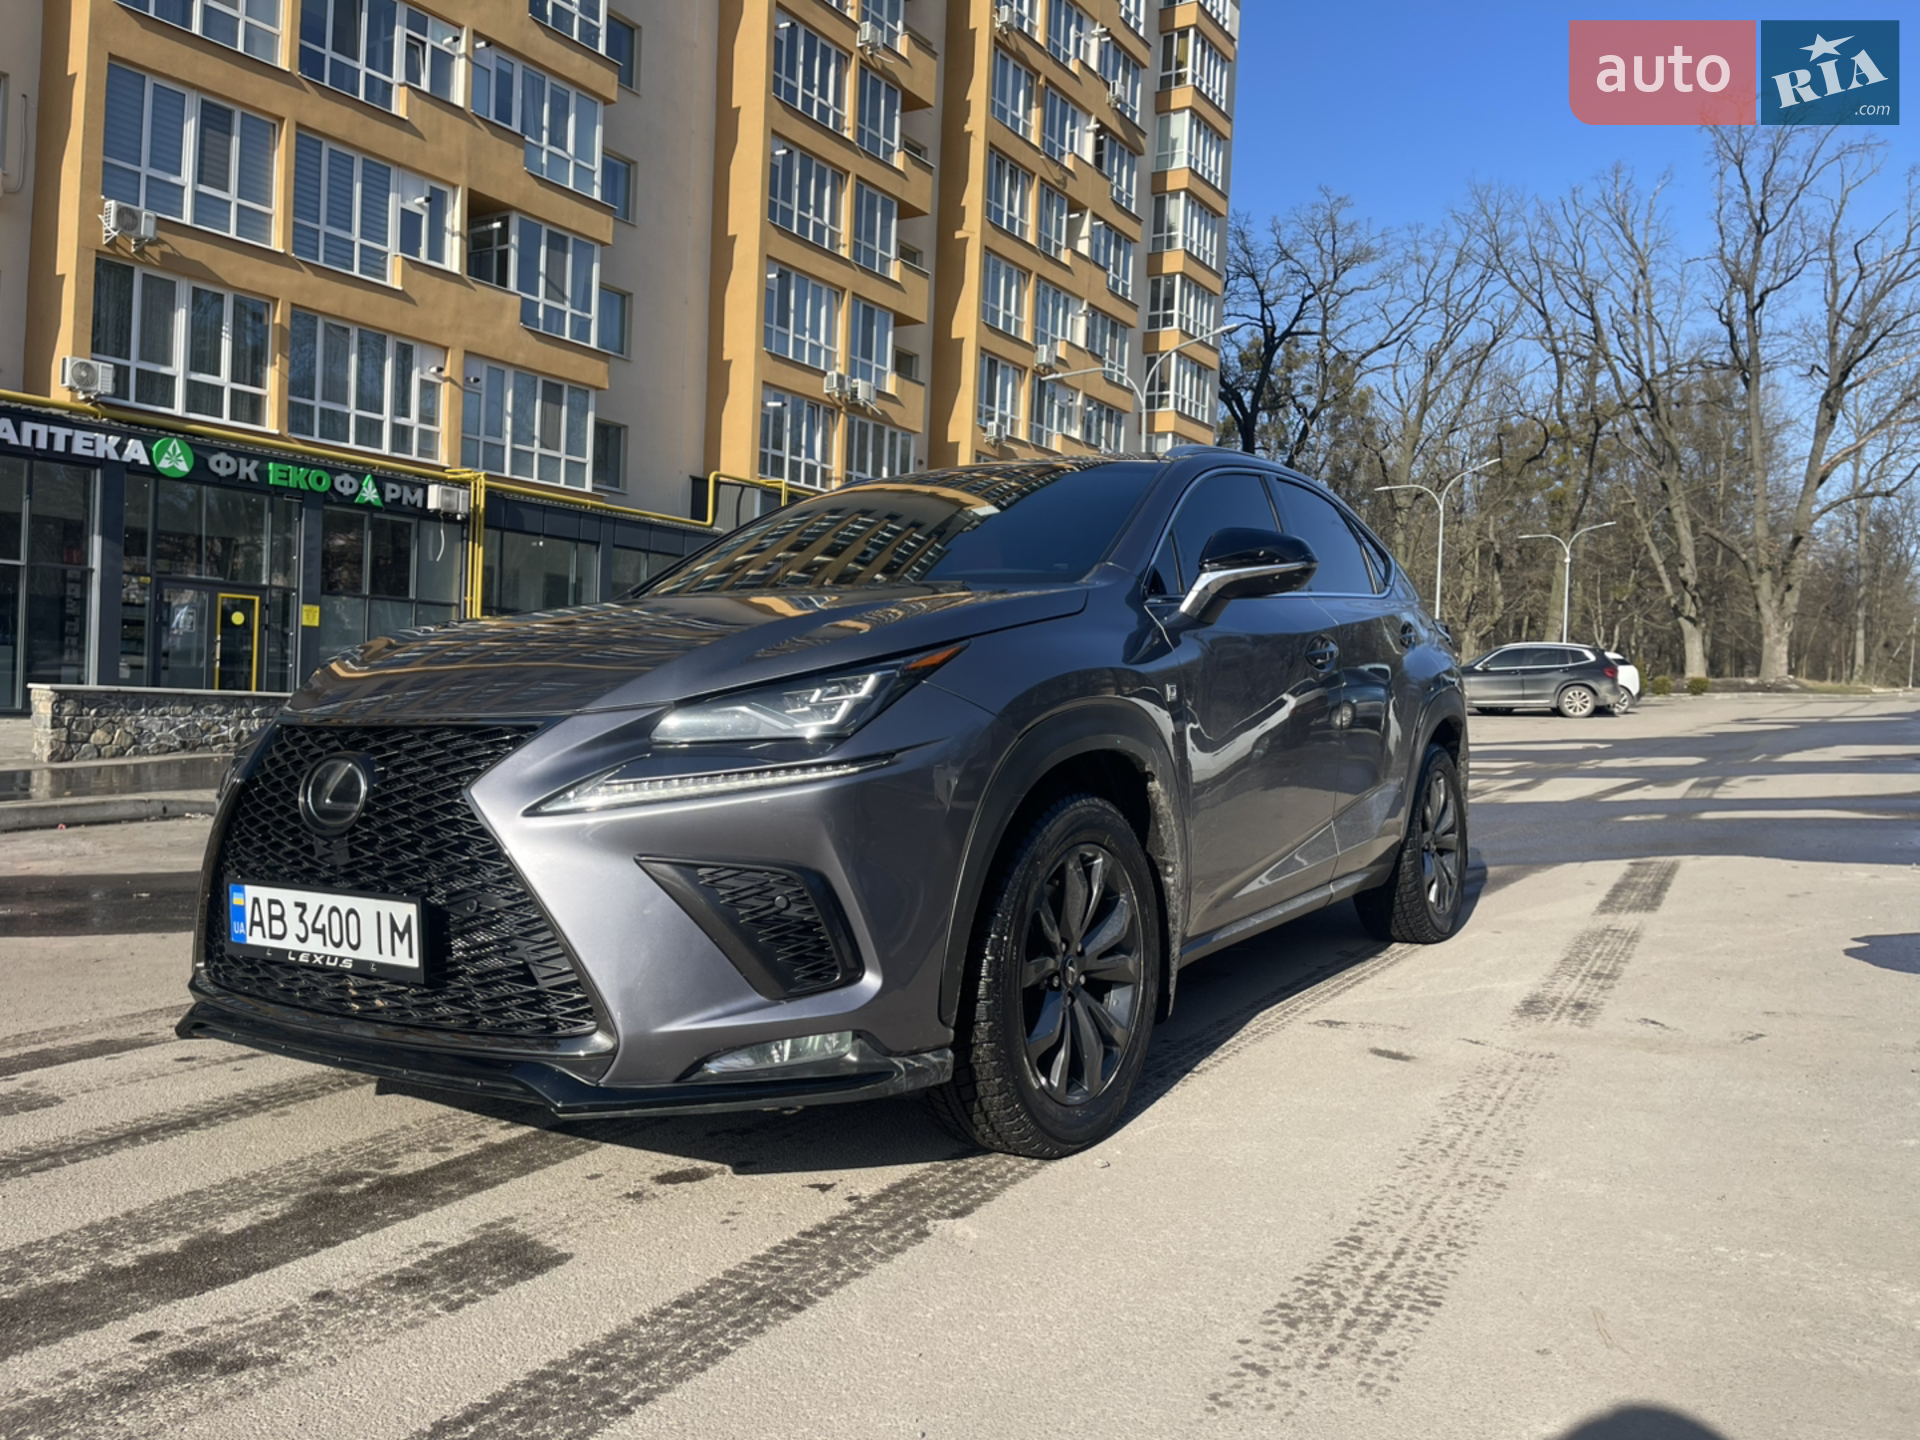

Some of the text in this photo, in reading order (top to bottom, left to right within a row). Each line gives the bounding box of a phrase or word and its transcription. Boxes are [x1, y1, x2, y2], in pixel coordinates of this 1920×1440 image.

[0, 417, 150, 466] АПТЕКА
[208, 452, 260, 482] ФК
[233, 922, 246, 934] UA
[294, 901, 361, 951] 3400
[287, 950, 353, 969] LEXUS
